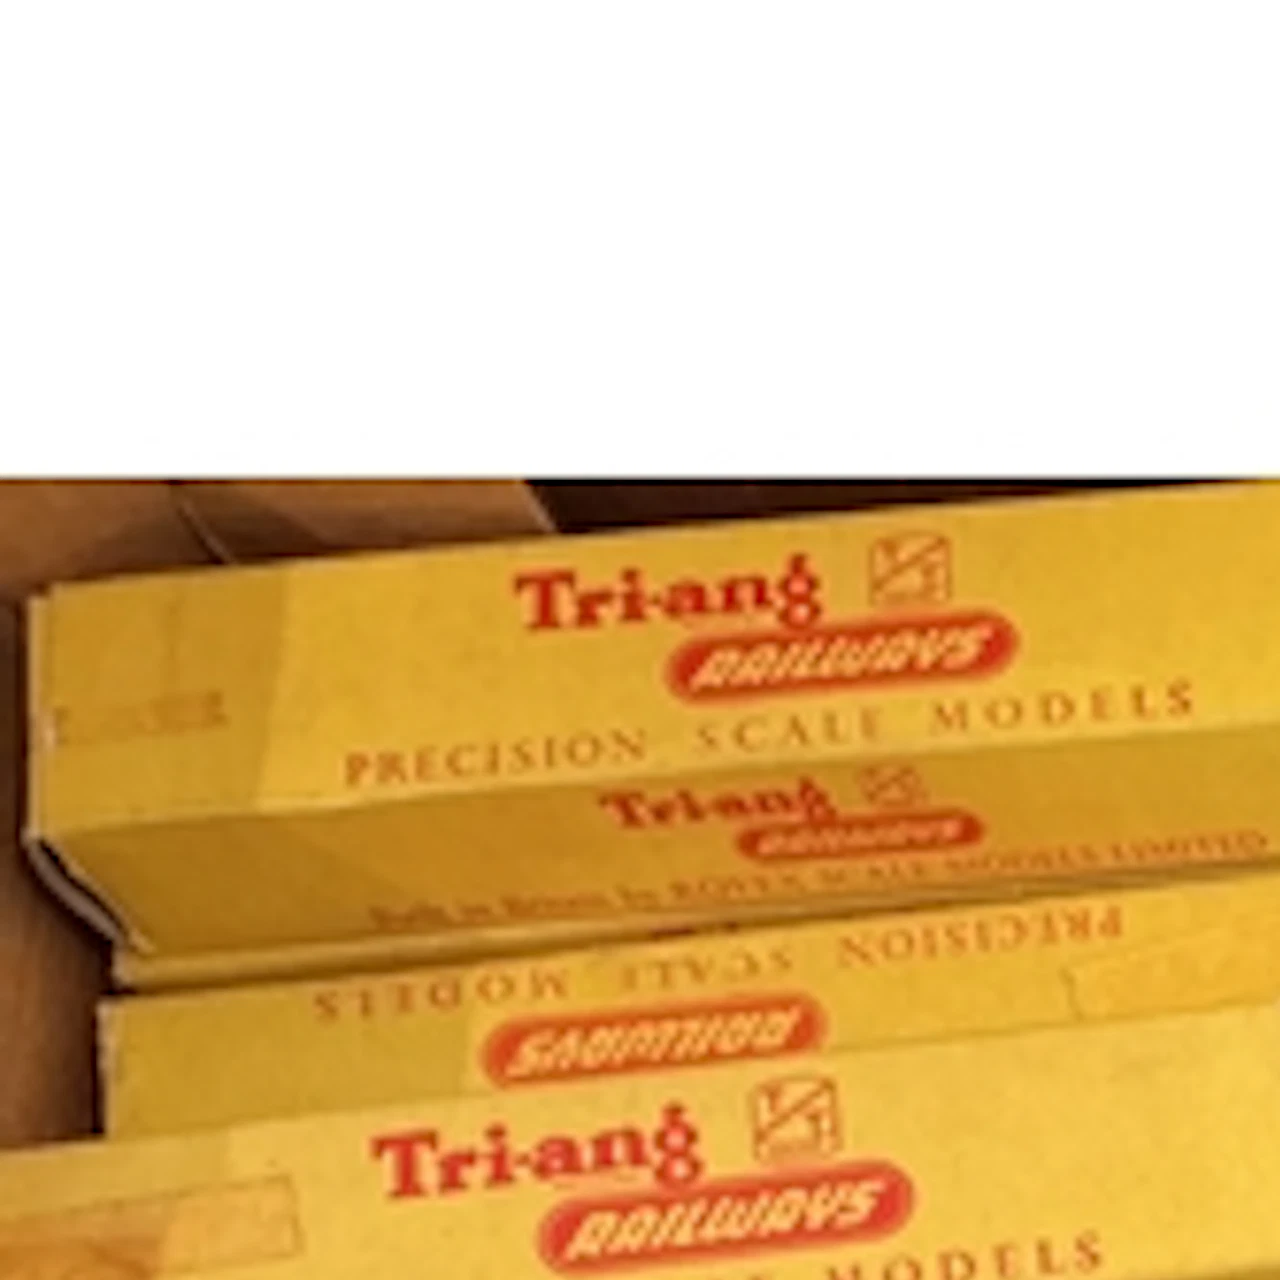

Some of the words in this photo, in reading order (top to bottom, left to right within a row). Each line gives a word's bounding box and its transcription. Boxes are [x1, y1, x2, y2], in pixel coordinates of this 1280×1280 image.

[686, 624, 994, 688] RAILWAYS
[343, 728, 646, 788] PRECISION
[696, 707, 882, 754] SCALE
[930, 680, 1194, 733] MODELS
[838, 904, 1124, 968] PRECISION
[311, 968, 569, 1025] MODELS
[620, 946, 795, 991] SCALE
[503, 1003, 801, 1078] RAILWAYS
[566, 1179, 886, 1263] RAILWAYS
